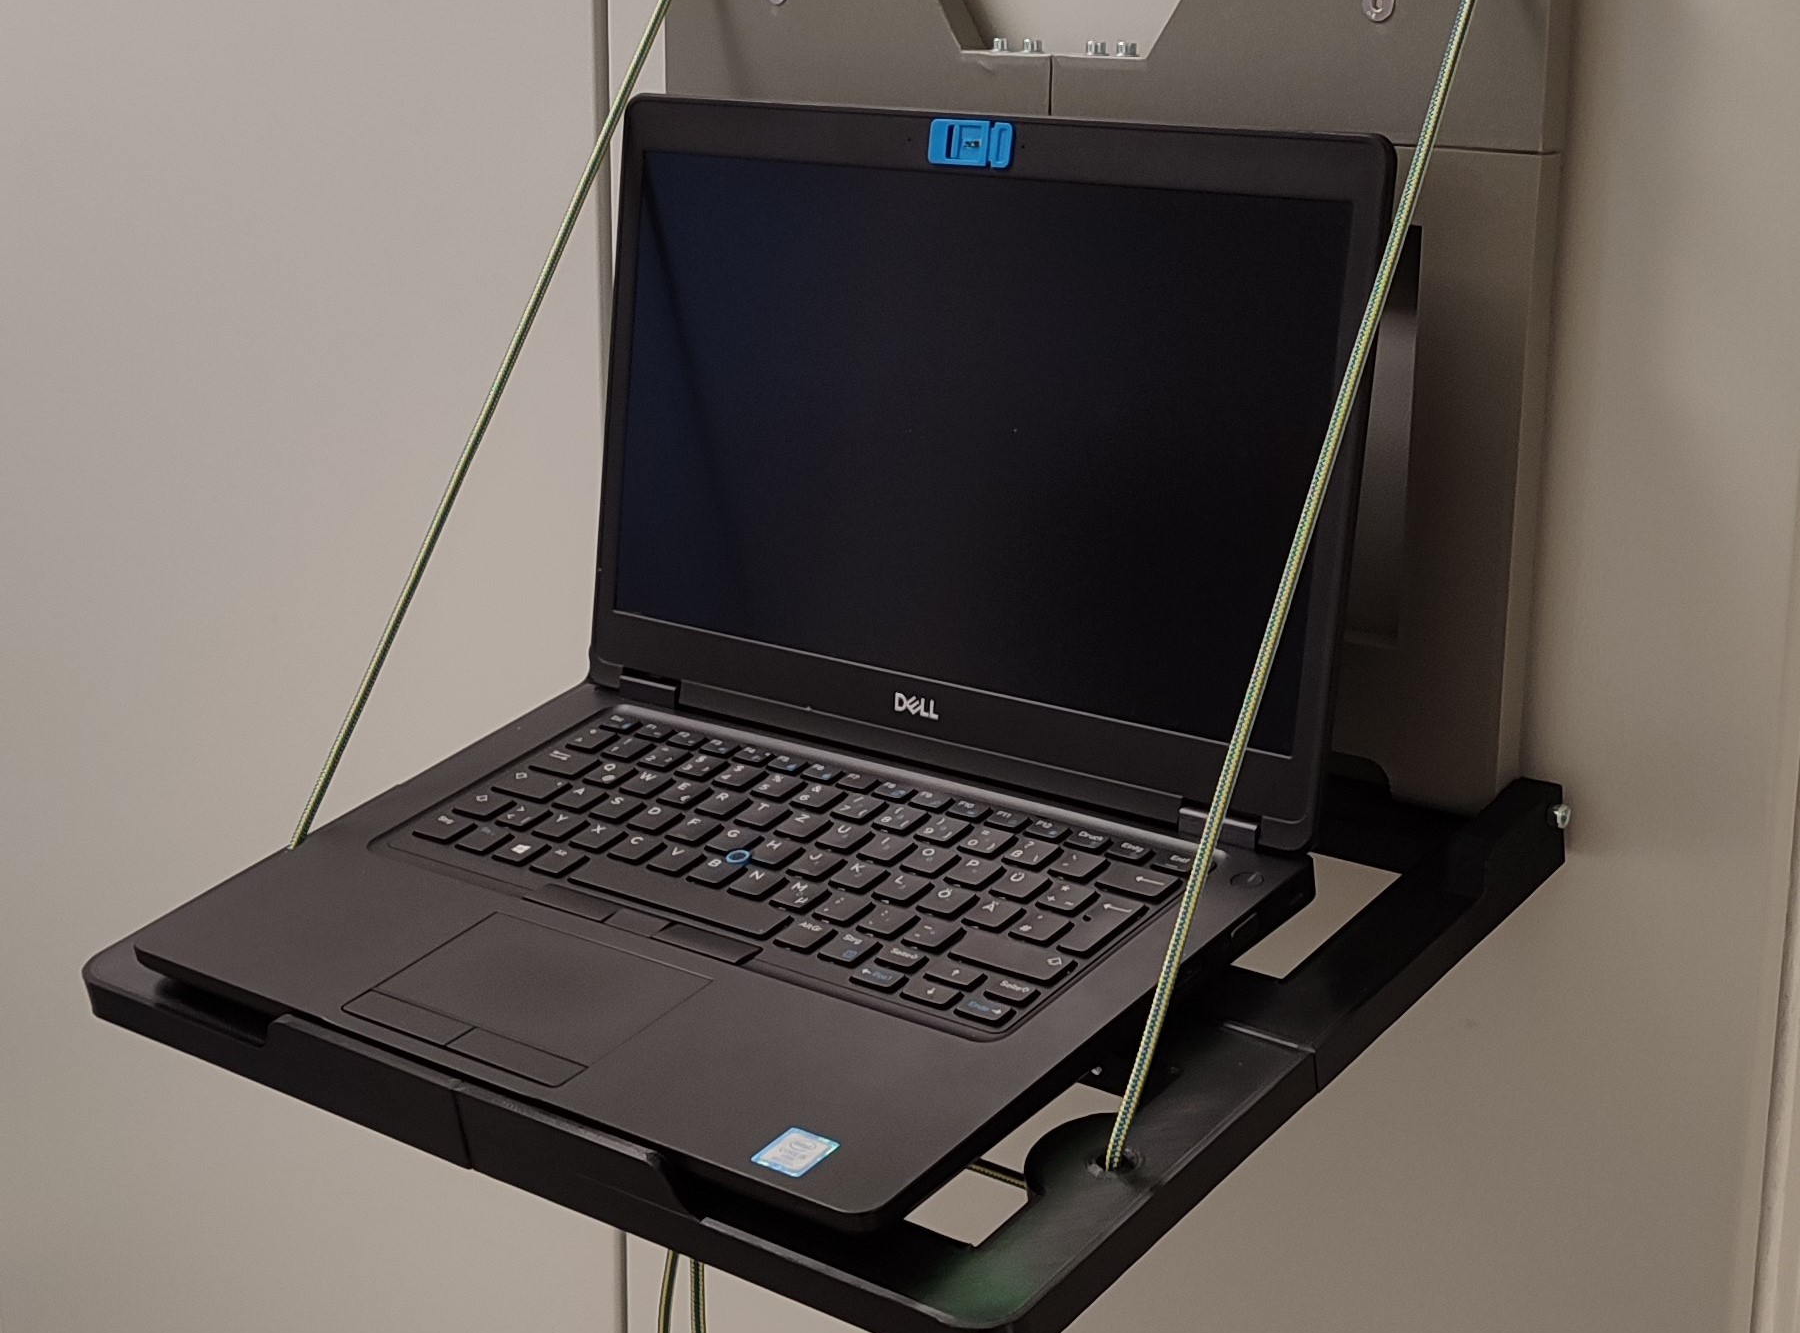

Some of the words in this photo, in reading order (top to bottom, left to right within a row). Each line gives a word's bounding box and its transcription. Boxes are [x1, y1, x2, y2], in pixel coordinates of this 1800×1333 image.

[894, 691, 939, 721] DELL
[639, 771, 657, 782] W
[572, 787, 586, 796] A
[677, 782, 692, 791] E
[610, 796, 625, 805] S
[715, 792, 730, 802] R
[647, 806, 662, 815] D
[757, 802, 770, 811] T
[556, 813, 569, 823] Y
[686, 817, 702, 826] F
[794, 813, 811, 824] Z
[590, 824, 607, 834] X
[726, 829, 741, 838] G
[837, 825, 852, 834] U
[630, 836, 645, 845] C
[765, 840, 783, 850] H
[671, 846, 686, 856] V
[808, 853, 823, 861] J
[707, 858, 722, 867] B
[850, 862, 866, 873] K
[965, 859, 980, 867] P
[748, 869, 766, 881] N
[894, 874, 904, 885] L
[1009, 871, 1026, 883] Ü
[790, 881, 809, 893] M
[937, 888, 953, 899] Ö
[981, 900, 1000, 913] Ä
